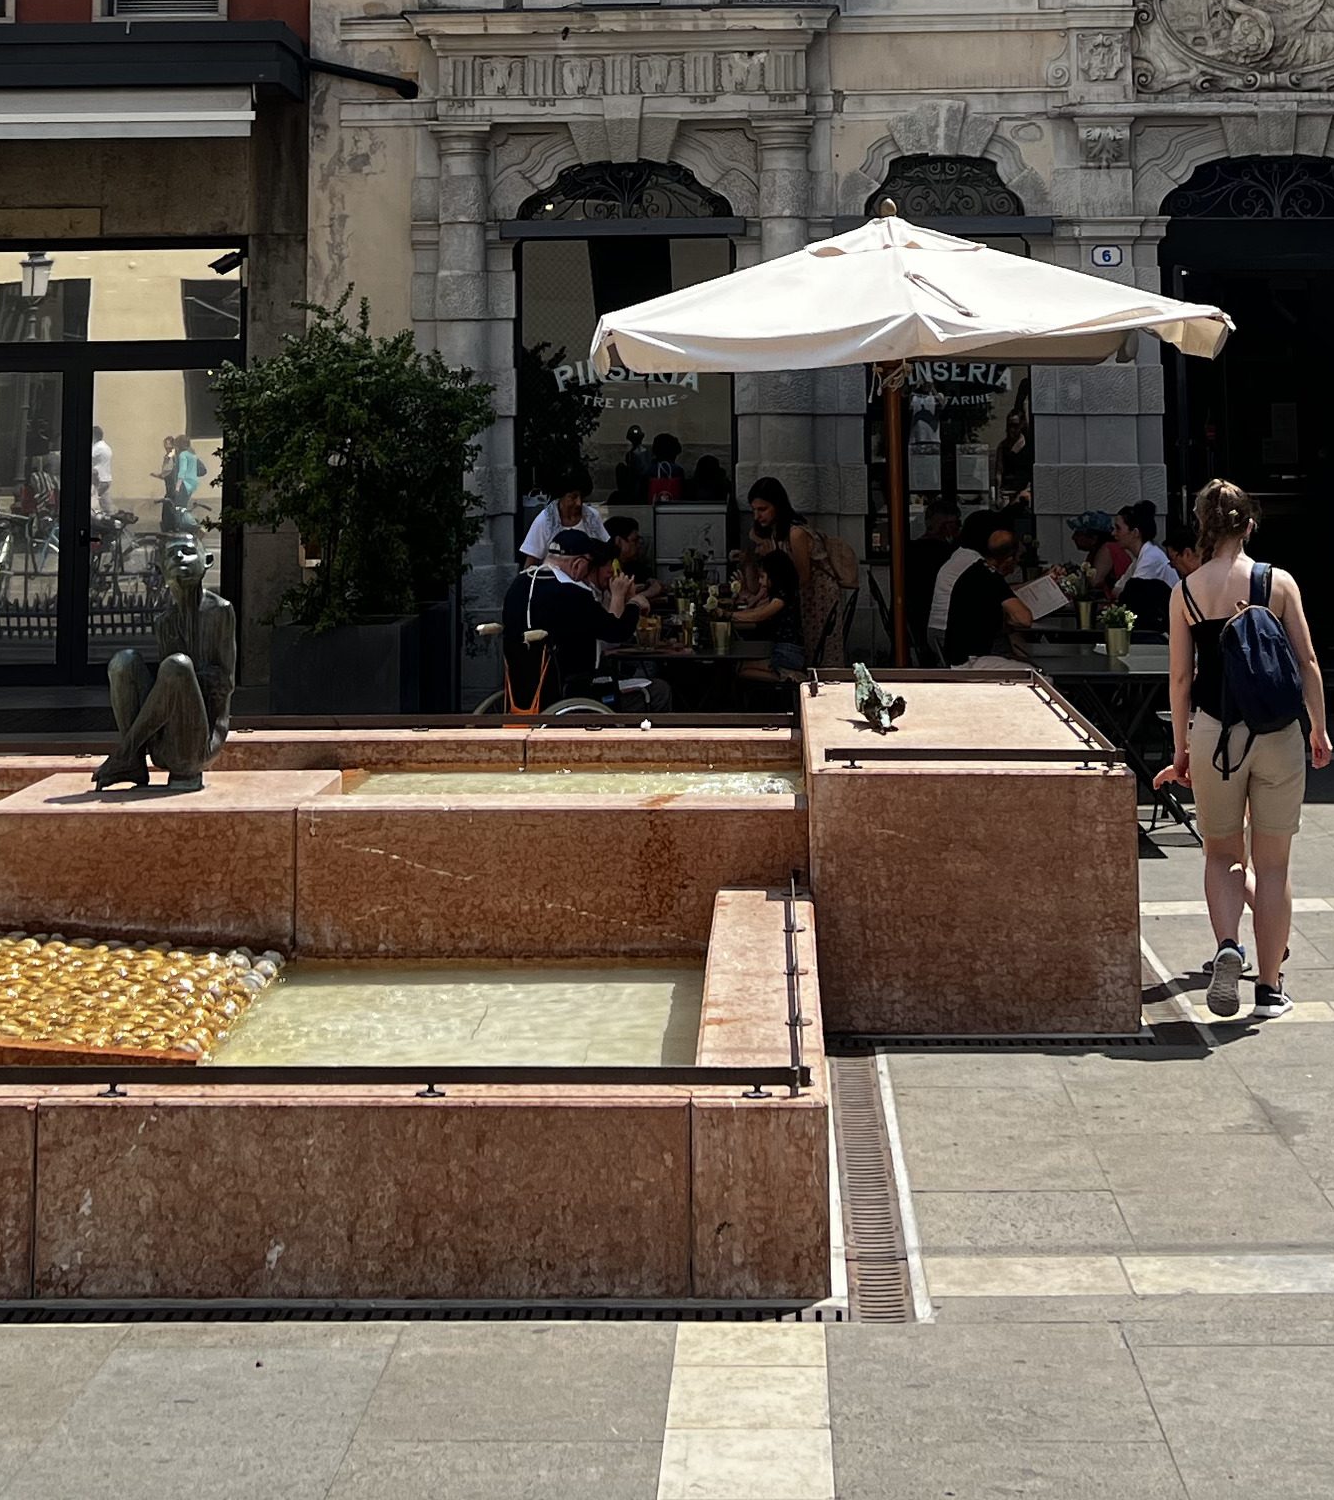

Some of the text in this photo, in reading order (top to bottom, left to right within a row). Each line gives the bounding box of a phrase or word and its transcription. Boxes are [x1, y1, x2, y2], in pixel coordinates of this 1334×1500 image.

[1102, 249, 1112, 263] 6
[582, 394, 678, 409] TRE FARINE
